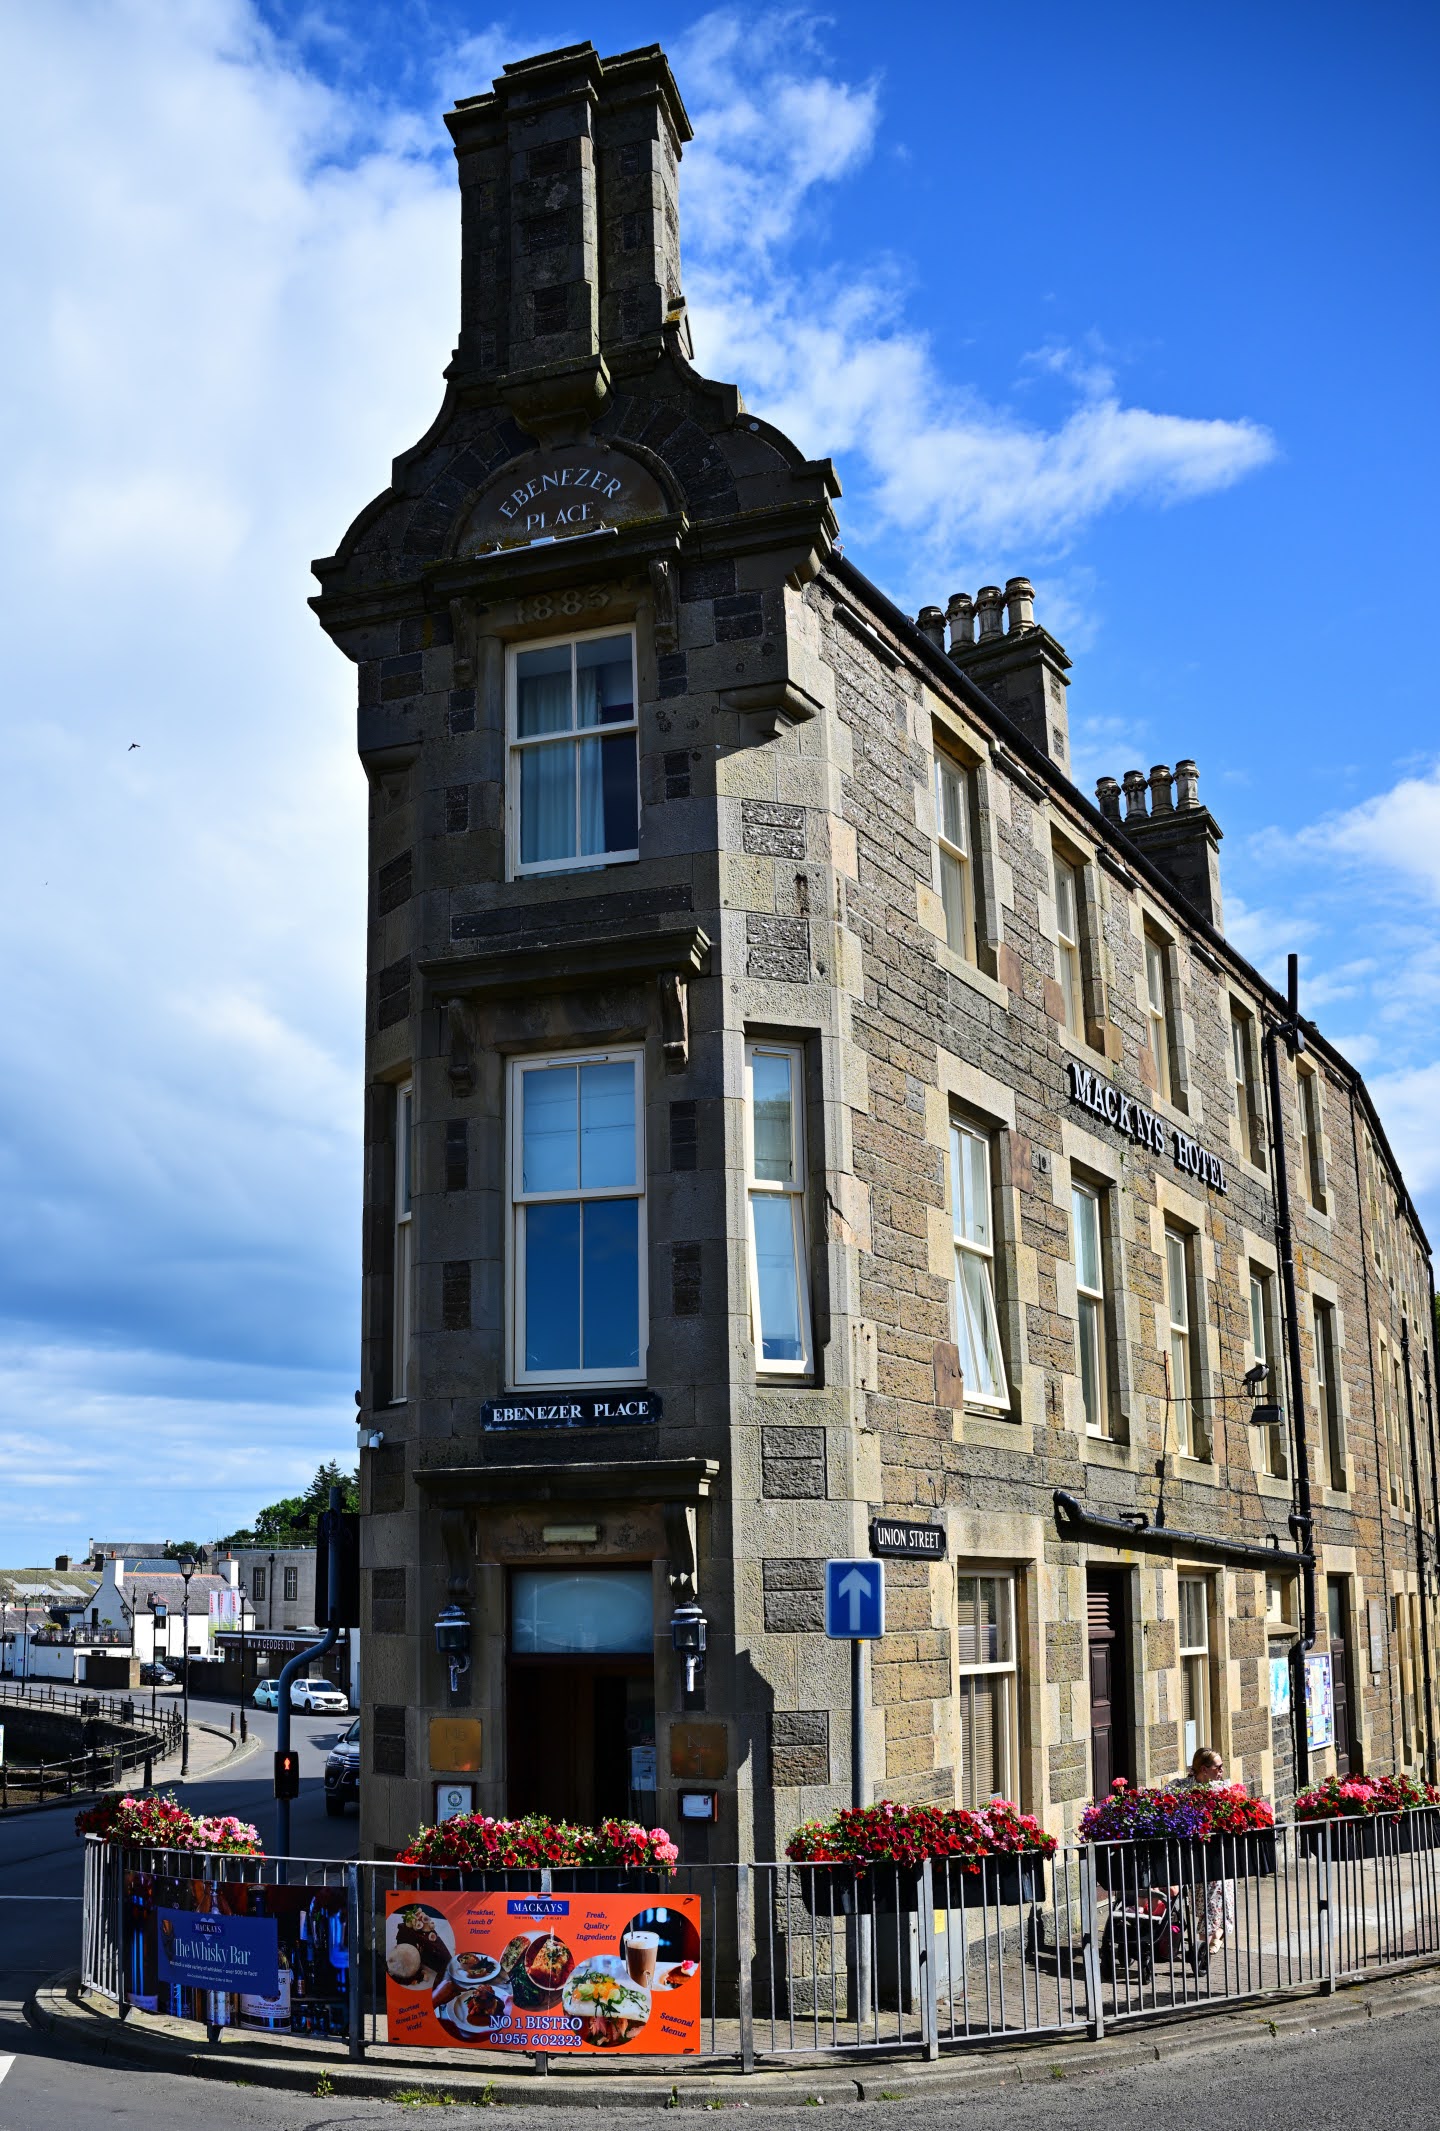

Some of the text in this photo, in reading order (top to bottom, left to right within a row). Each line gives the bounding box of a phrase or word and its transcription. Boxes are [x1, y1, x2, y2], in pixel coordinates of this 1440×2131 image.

[498, 468, 622, 518] EBENEZER
[526, 501, 594, 531] PLACE
[1072, 1062, 1229, 1194] MACKAYS HOTEL
[492, 1401, 649, 1422] EBENEZER PLACE
[877, 1527, 940, 1549] UNION STREET
[262, 1640, 284, 1650] GEDDES
[513, 1902, 563, 1913] MACKAYS
[585, 1911, 607, 1919] Fresh,
[194, 1923, 222, 1933] MACKAYS
[583, 1922, 610, 1930] Quality
[576, 1933, 617, 1941] Ingredients
[174, 1938, 251, 1968] The Whisky Bar
[489, 2015, 583, 2032] NO 1 BISTRO
[660, 2012, 695, 2027] Seasonal
[660, 2025, 687, 2038] Menus
[489, 2032, 582, 2047] 01955 602323
